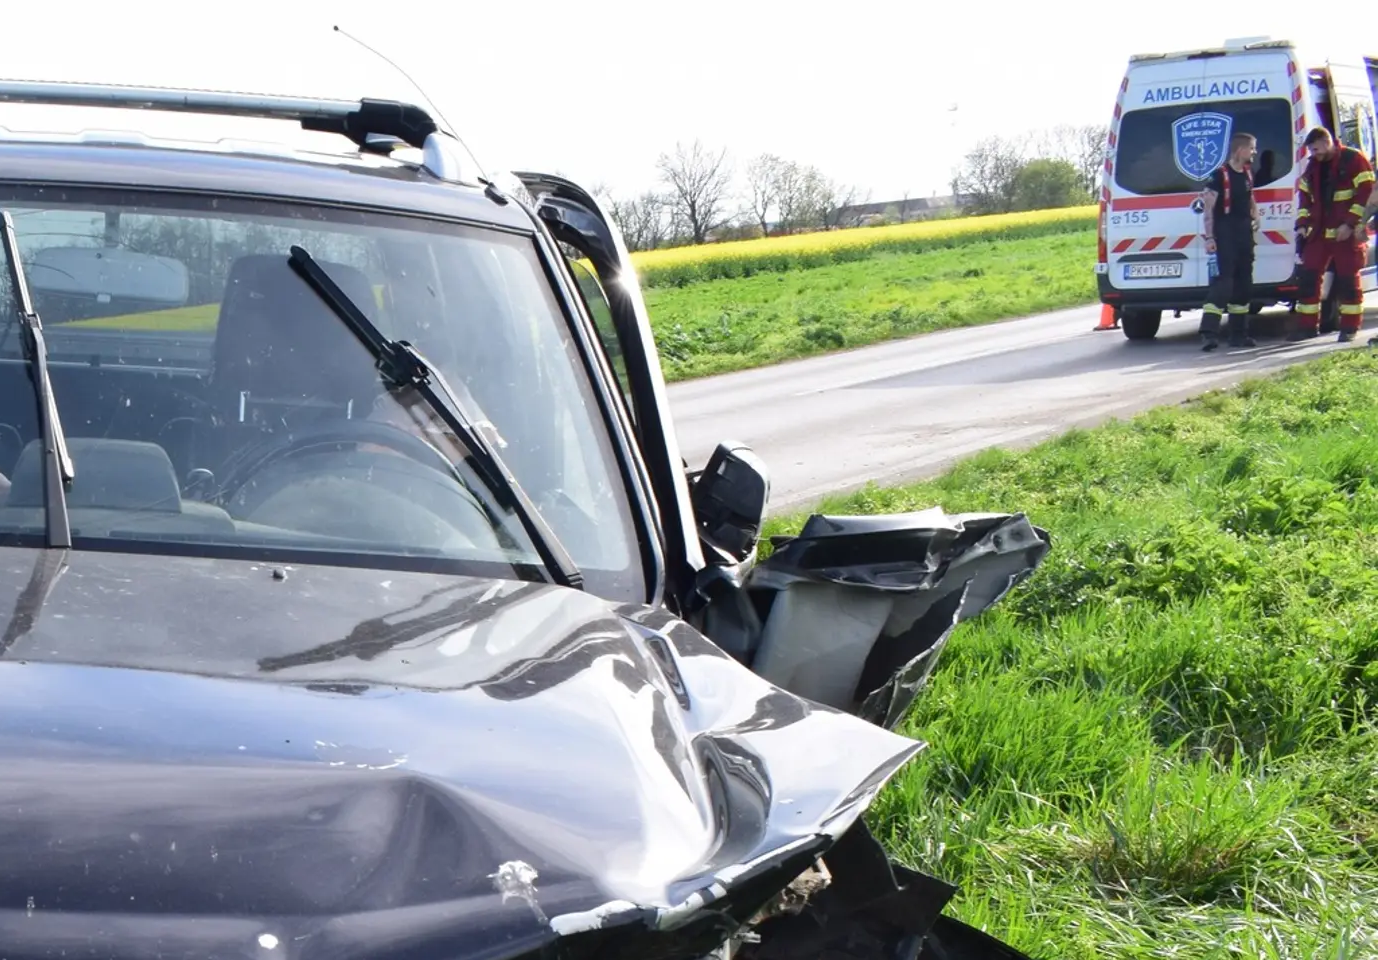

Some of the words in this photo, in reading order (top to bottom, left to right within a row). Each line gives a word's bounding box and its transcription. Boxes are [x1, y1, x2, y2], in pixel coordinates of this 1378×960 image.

[1142, 78, 1270, 104] AMBULANCIA
[1181, 120, 1199, 131] LIFE
[1201, 119, 1222, 129] STAR
[1269, 203, 1293, 216] 112
[1123, 210, 1150, 224] 155
